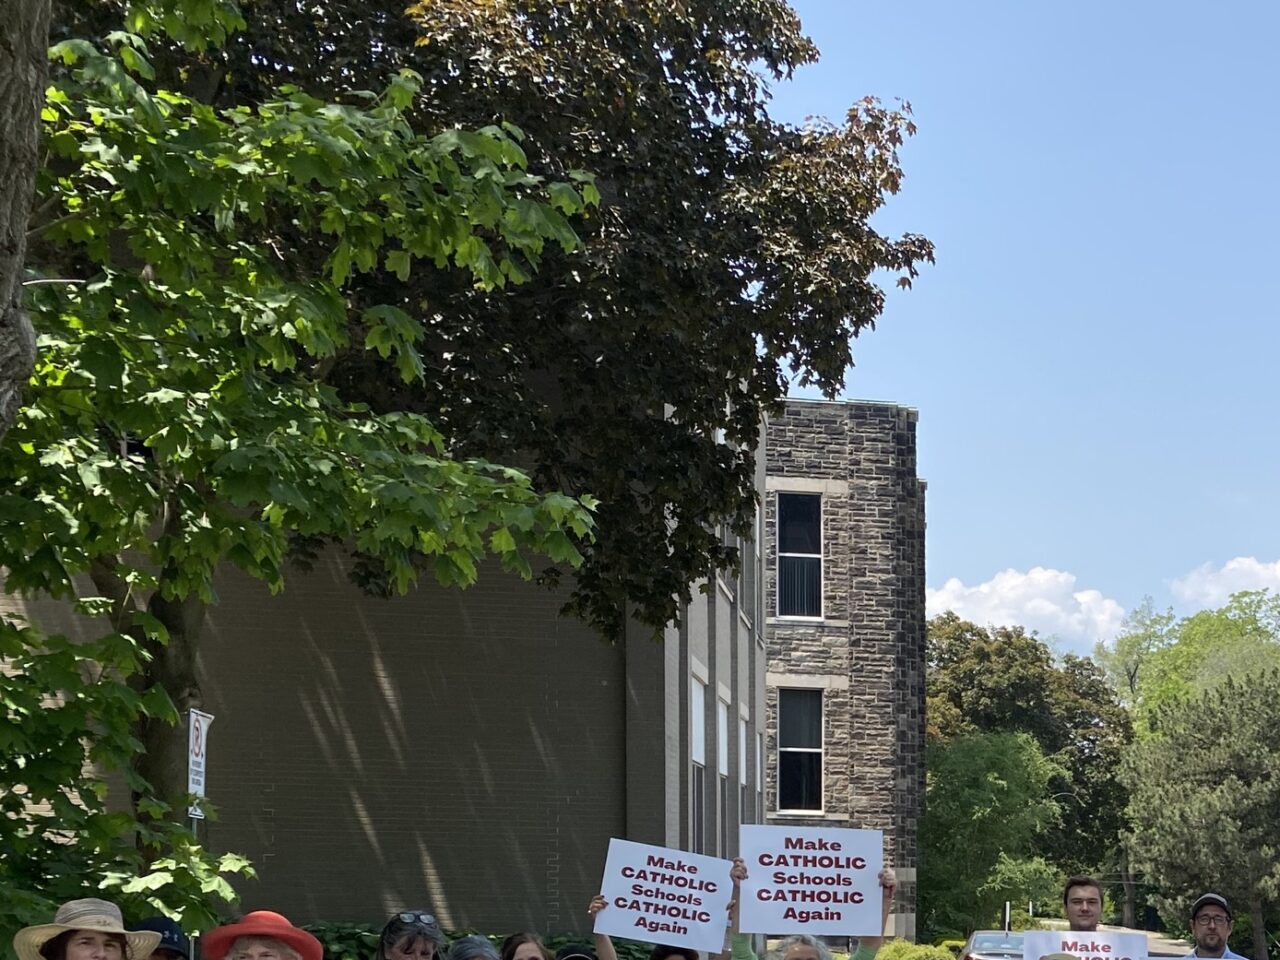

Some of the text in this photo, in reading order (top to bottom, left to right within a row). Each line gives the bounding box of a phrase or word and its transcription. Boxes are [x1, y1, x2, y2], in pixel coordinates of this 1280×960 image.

[784, 837, 842, 852] Make
[646, 855, 698, 874] Make
[758, 853, 866, 870] CATHOLIC
[621, 866, 718, 893] CATHOLIC
[773, 871, 853, 887] Schools
[631, 883, 702, 906] Schools
[756, 888, 864, 904] CATHOLIC
[614, 897, 711, 923] CATHOLIC
[783, 907, 842, 923] Again
[634, 916, 688, 935] Again
[1061, 941, 1112, 953] Make
